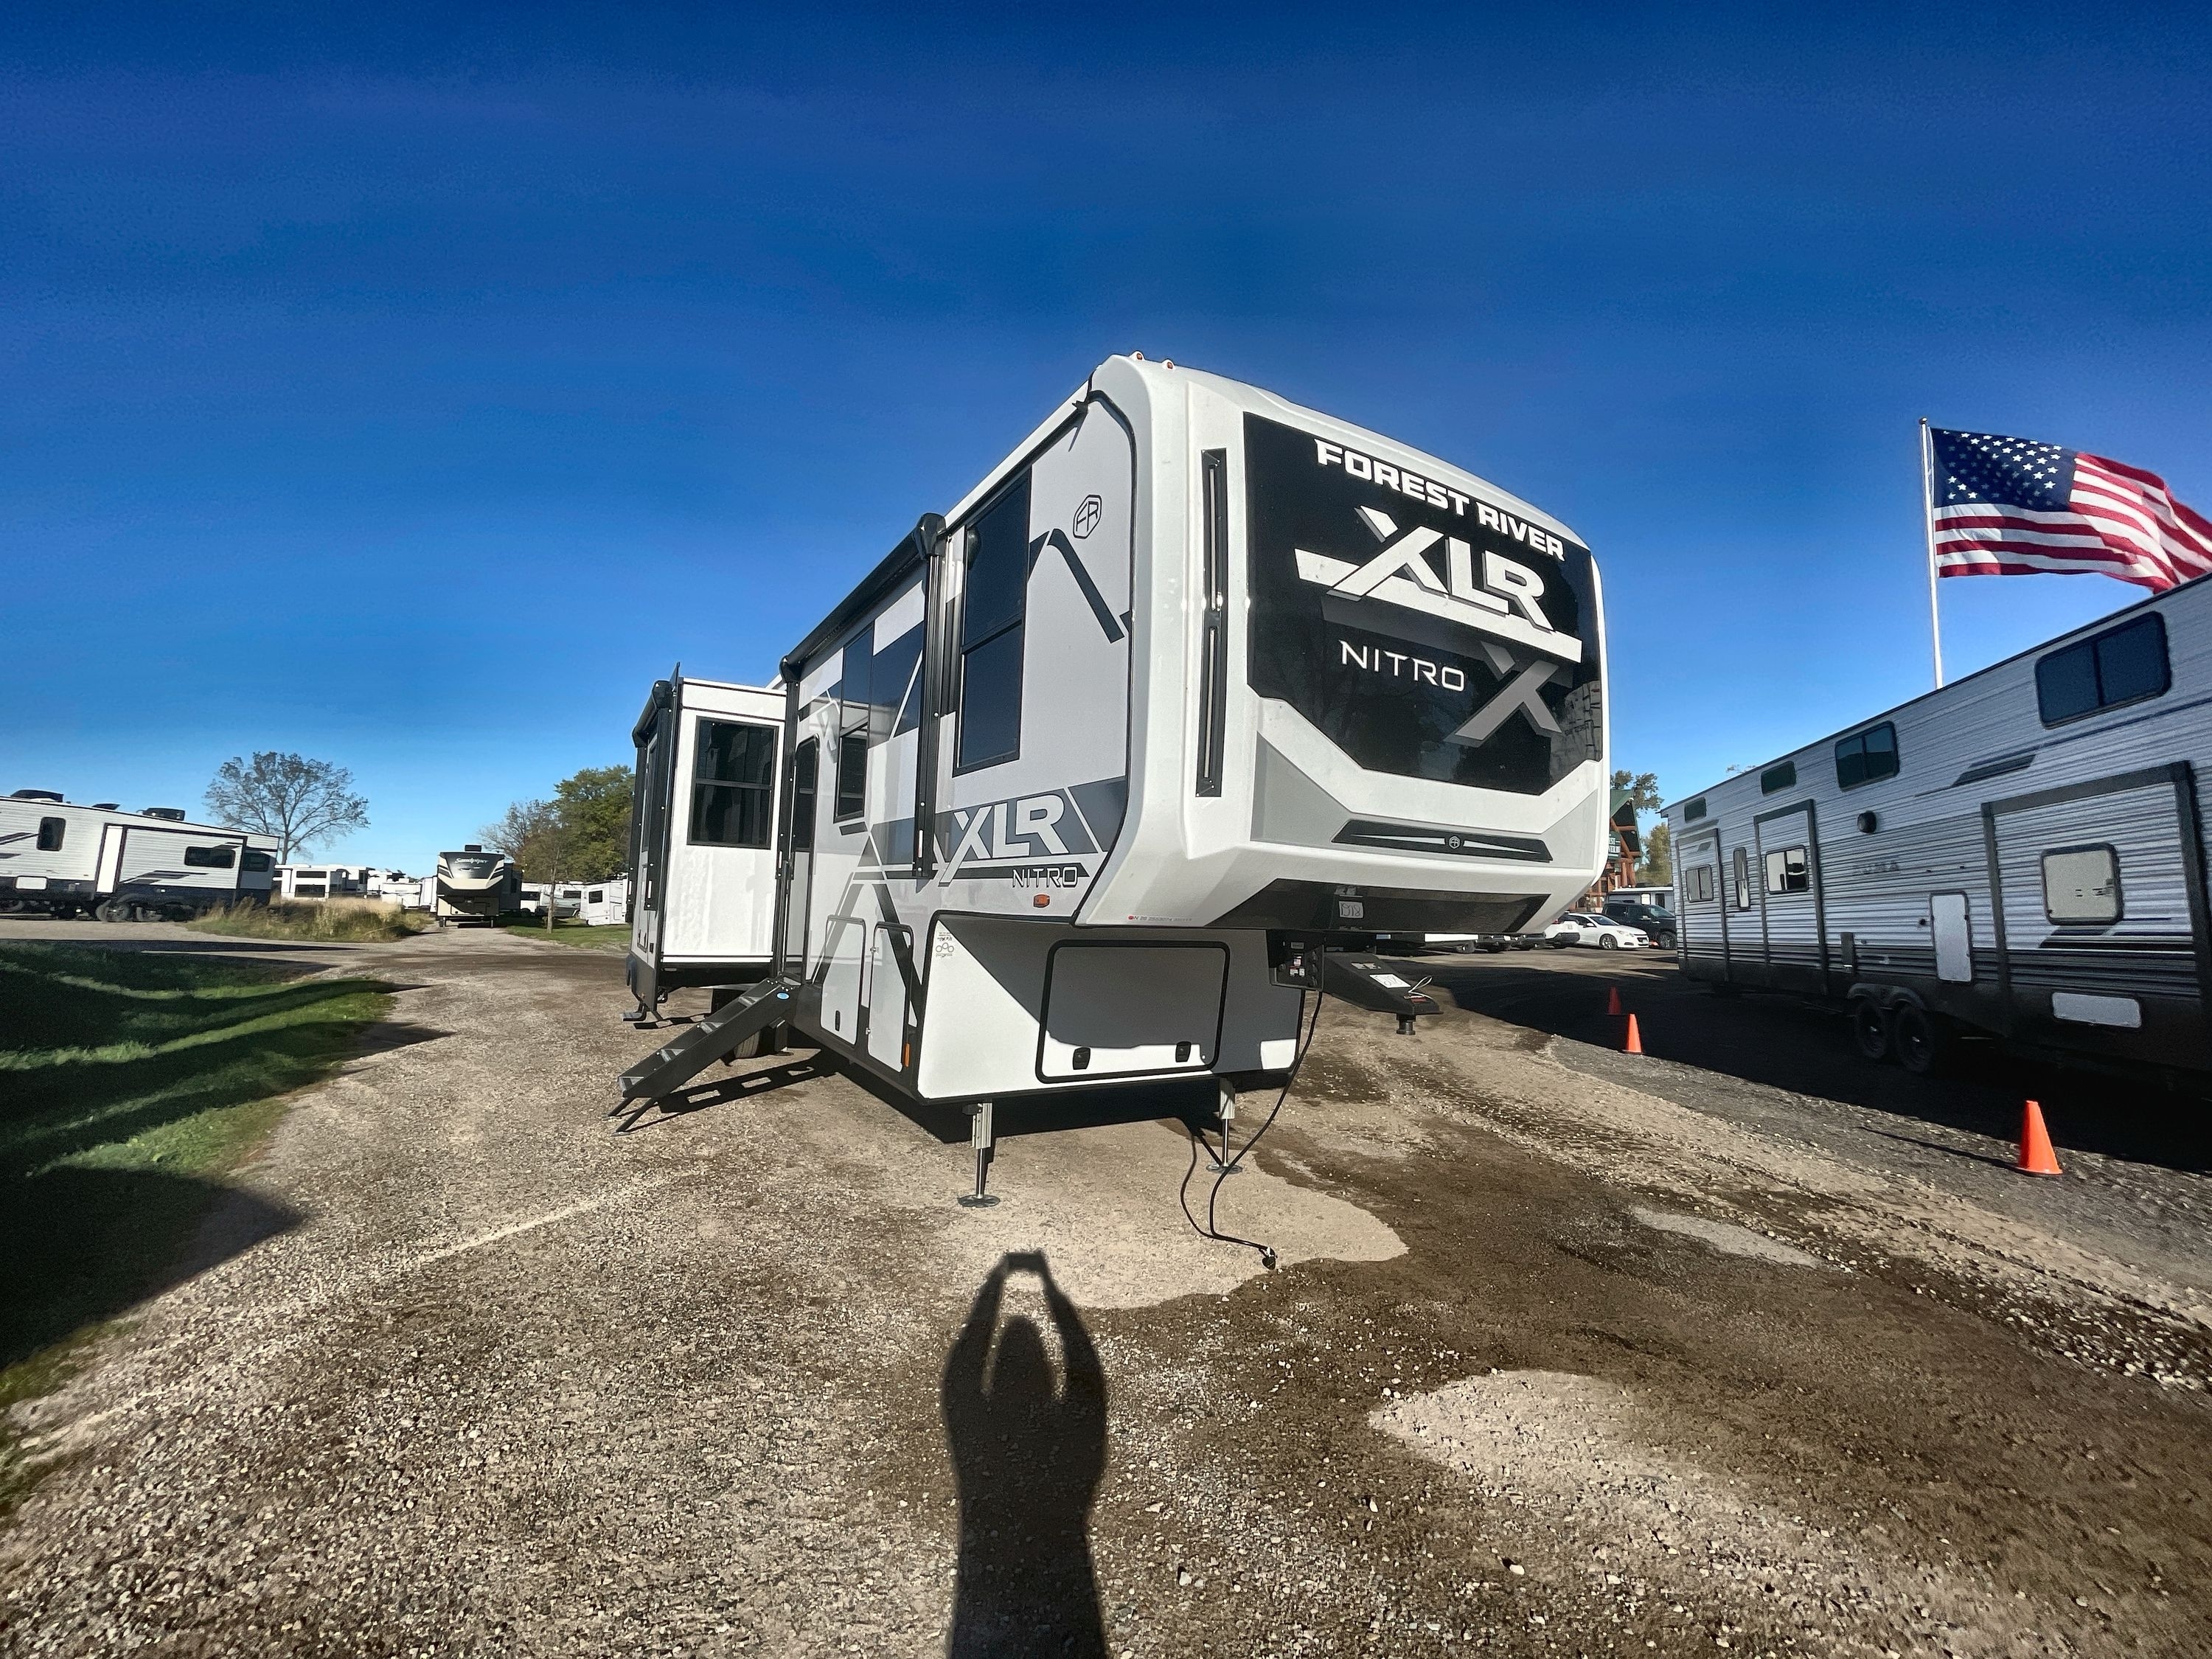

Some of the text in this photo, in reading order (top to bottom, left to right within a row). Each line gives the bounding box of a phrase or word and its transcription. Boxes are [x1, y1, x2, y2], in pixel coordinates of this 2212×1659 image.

[1314, 438, 1565, 562] FOREST RIVER
[1326, 505, 1554, 634] XLR
[1338, 639, 1465, 692] NITRO
[938, 793, 1070, 887] XLR
[1012, 866, 1078, 888] NITRO
